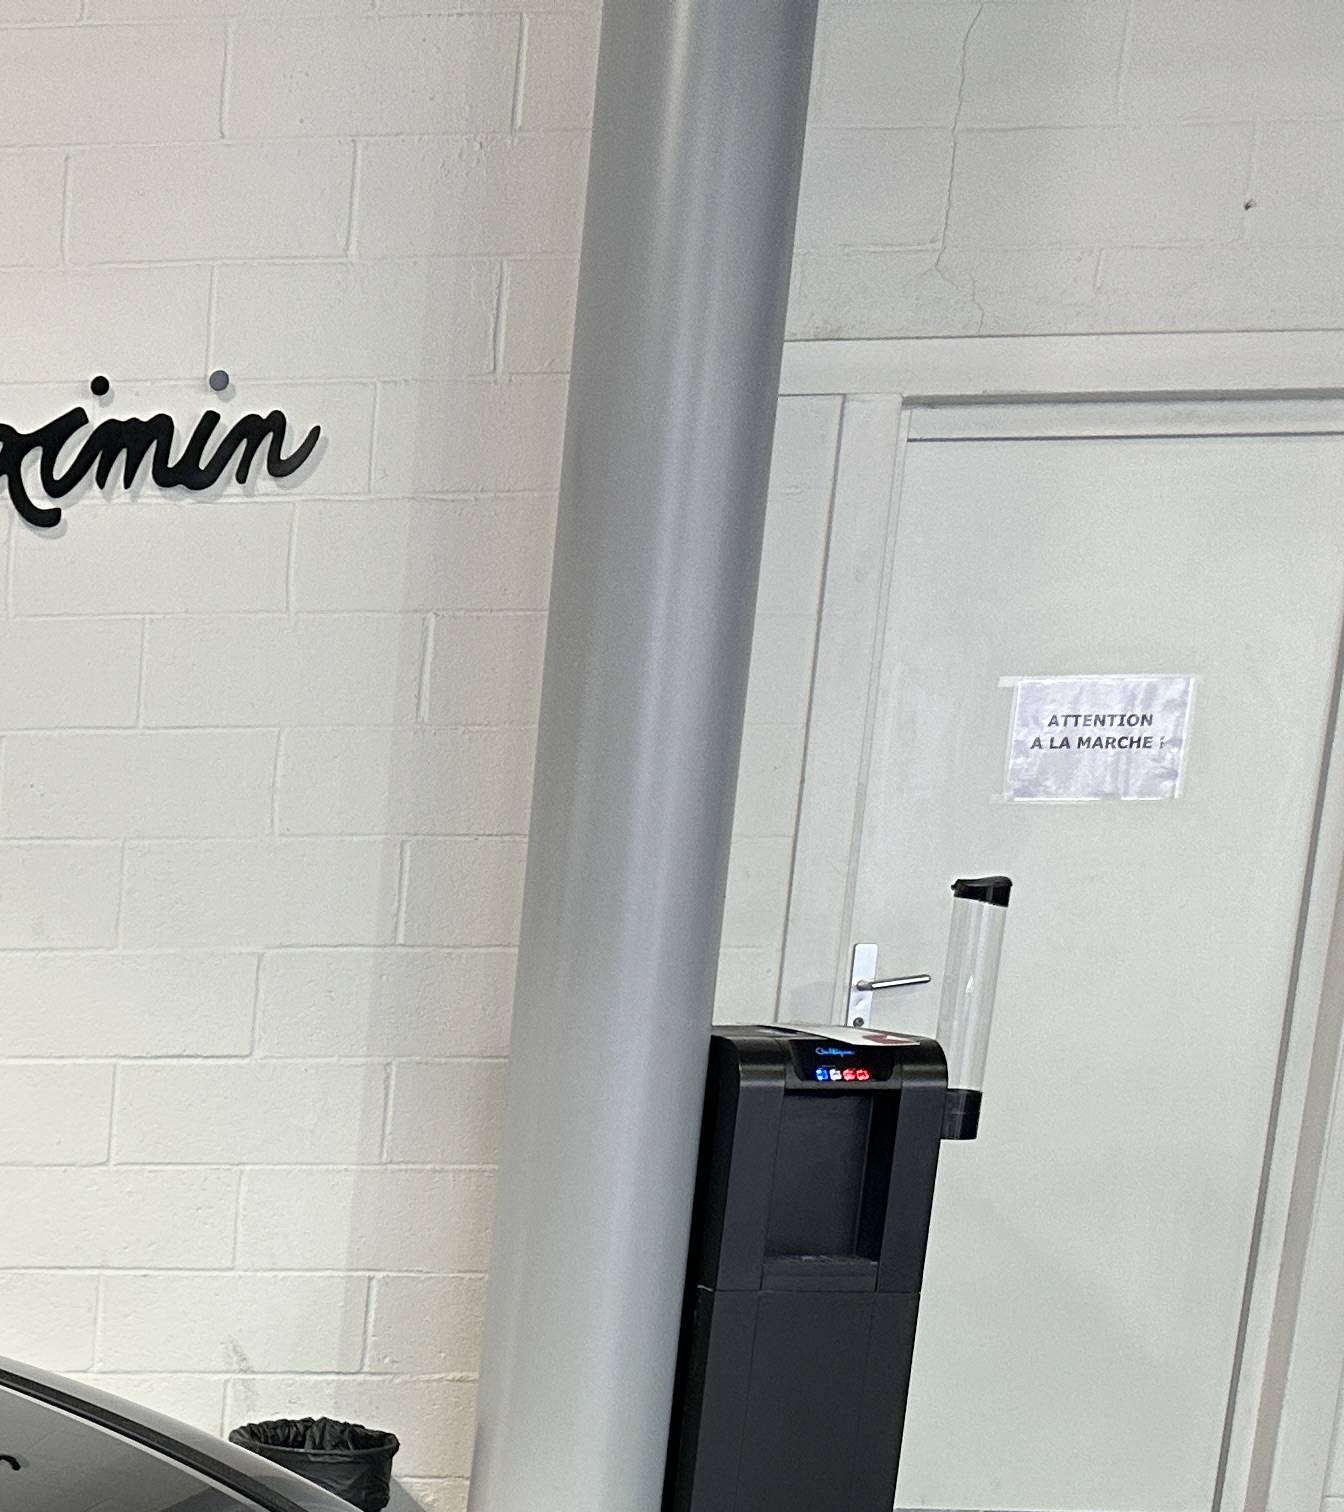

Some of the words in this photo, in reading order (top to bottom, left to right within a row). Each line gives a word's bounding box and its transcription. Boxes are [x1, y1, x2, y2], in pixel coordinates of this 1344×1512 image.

[1048, 714, 1154, 727] ATTENTION
[1030, 736, 1043, 750] A
[1049, 736, 1071, 750] LA
[1077, 735, 1153, 749] MARCHE
